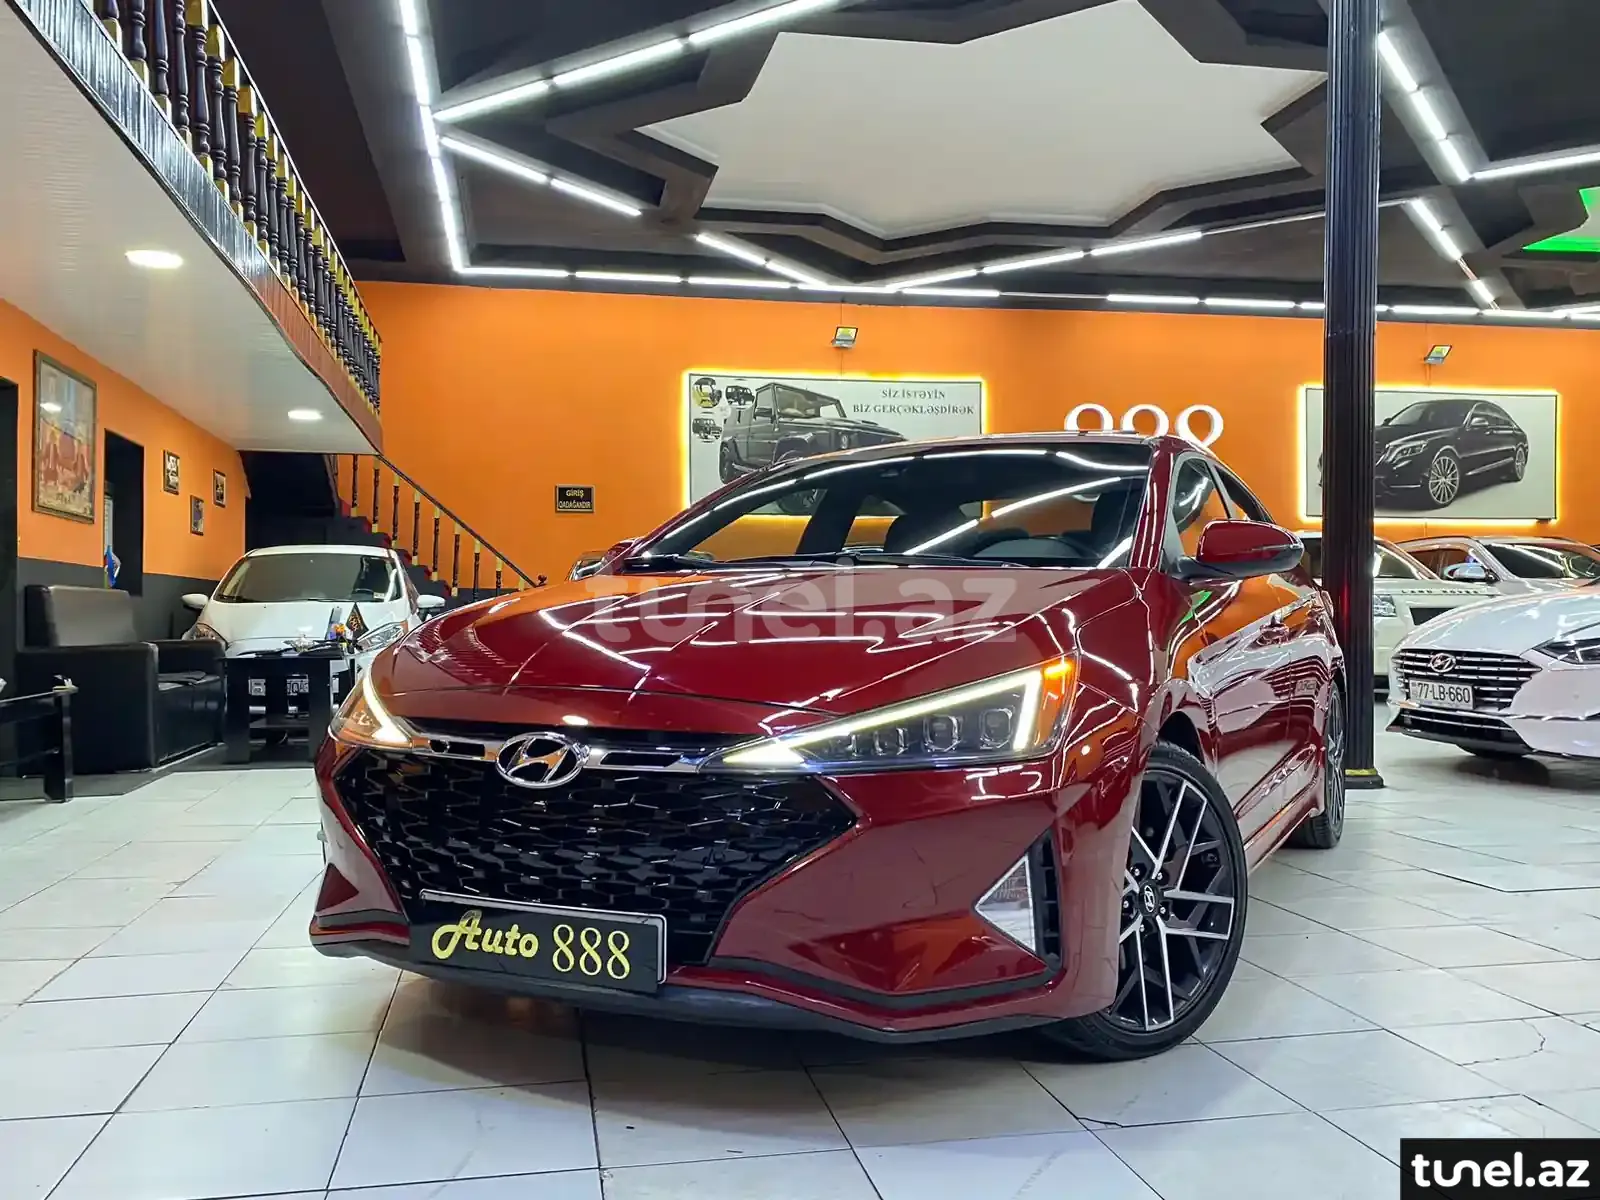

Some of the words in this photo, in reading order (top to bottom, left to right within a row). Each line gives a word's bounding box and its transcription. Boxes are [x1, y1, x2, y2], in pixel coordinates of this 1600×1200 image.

[881, 388, 899, 399] SİZ
[901, 388, 945, 400] İSTƏYİN
[853, 403, 871, 414] BİZ
[431, 909, 539, 960] Auto
[552, 924, 631, 980] 888
